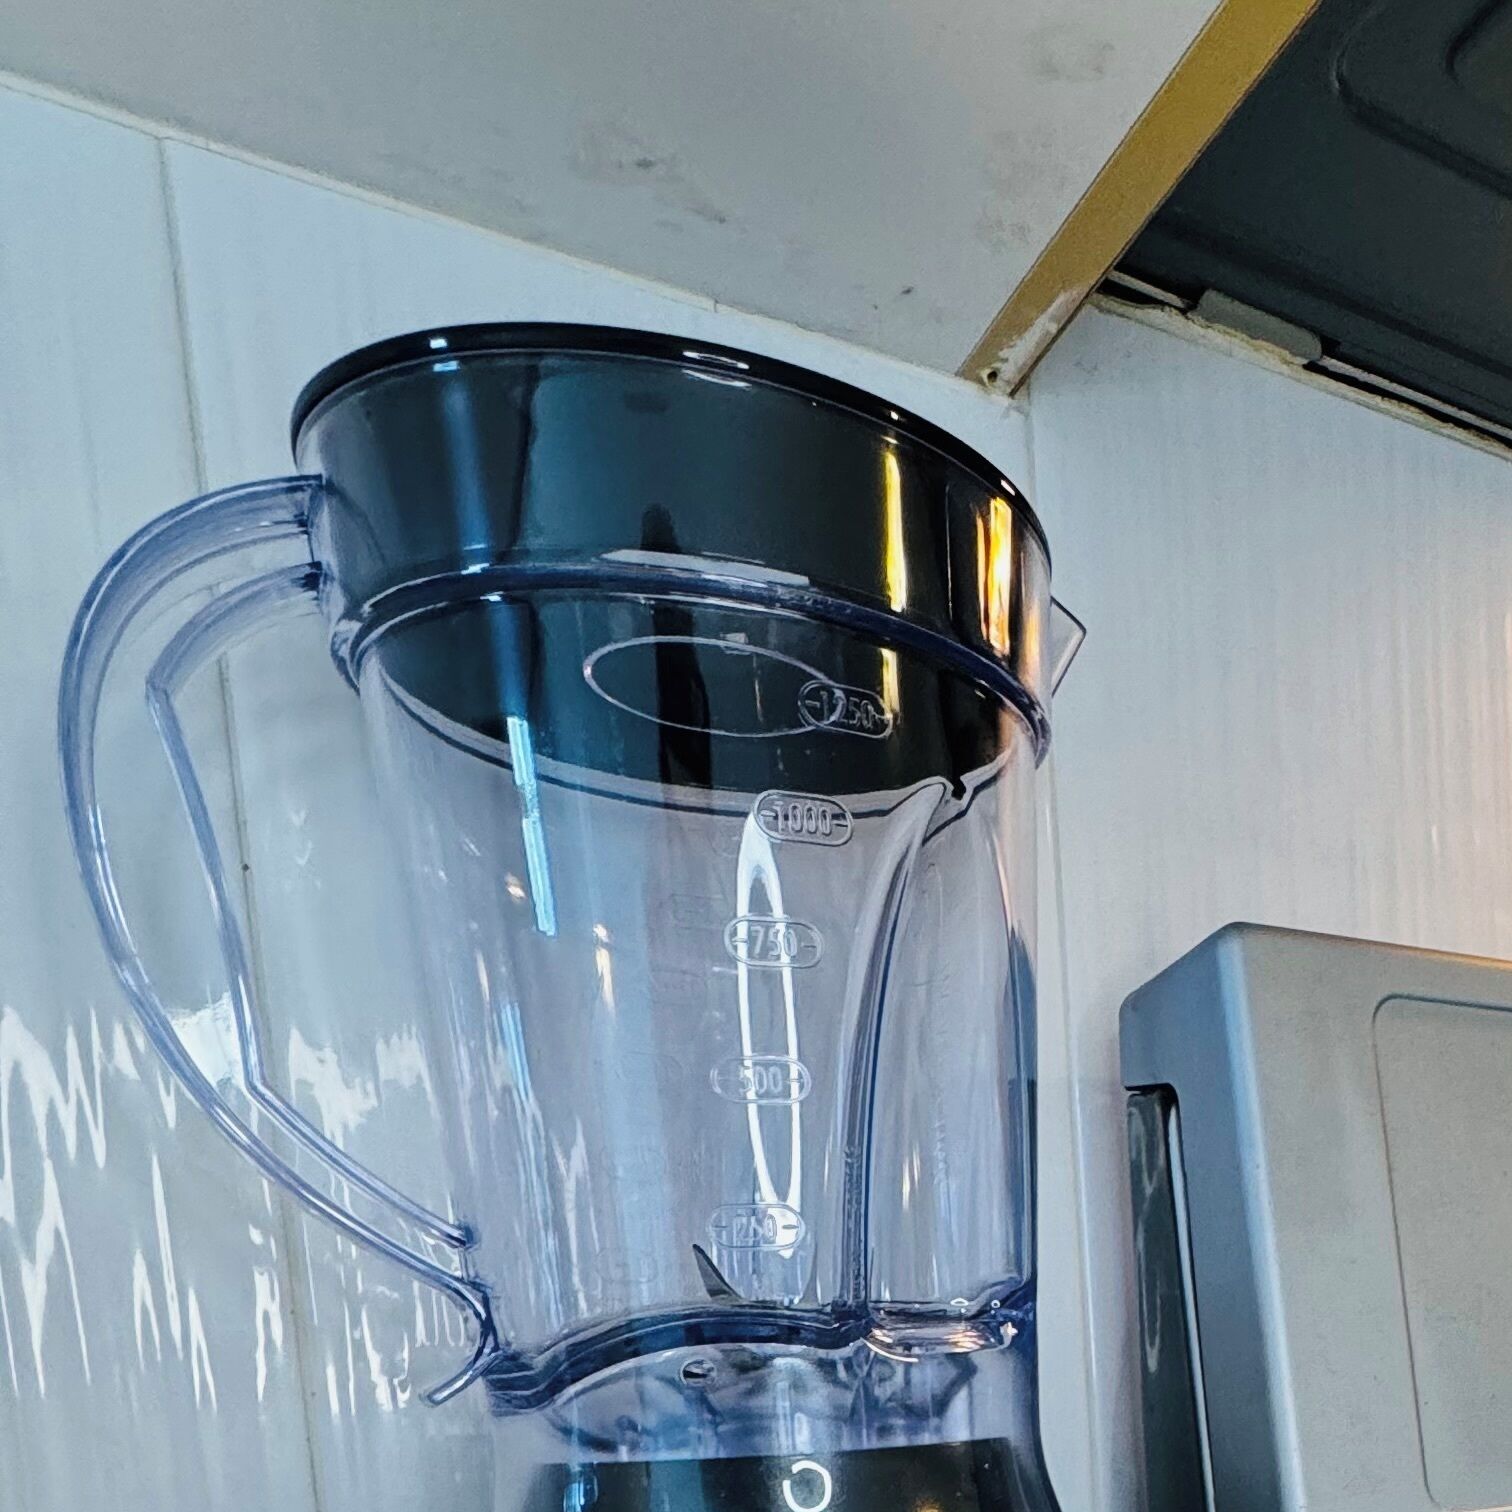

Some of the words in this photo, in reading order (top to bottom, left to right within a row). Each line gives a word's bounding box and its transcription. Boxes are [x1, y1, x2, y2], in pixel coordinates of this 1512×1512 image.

[776, 802, 833, 837] 1000
[749, 924, 798, 959] 750
[738, 1065, 783, 1095] 500
